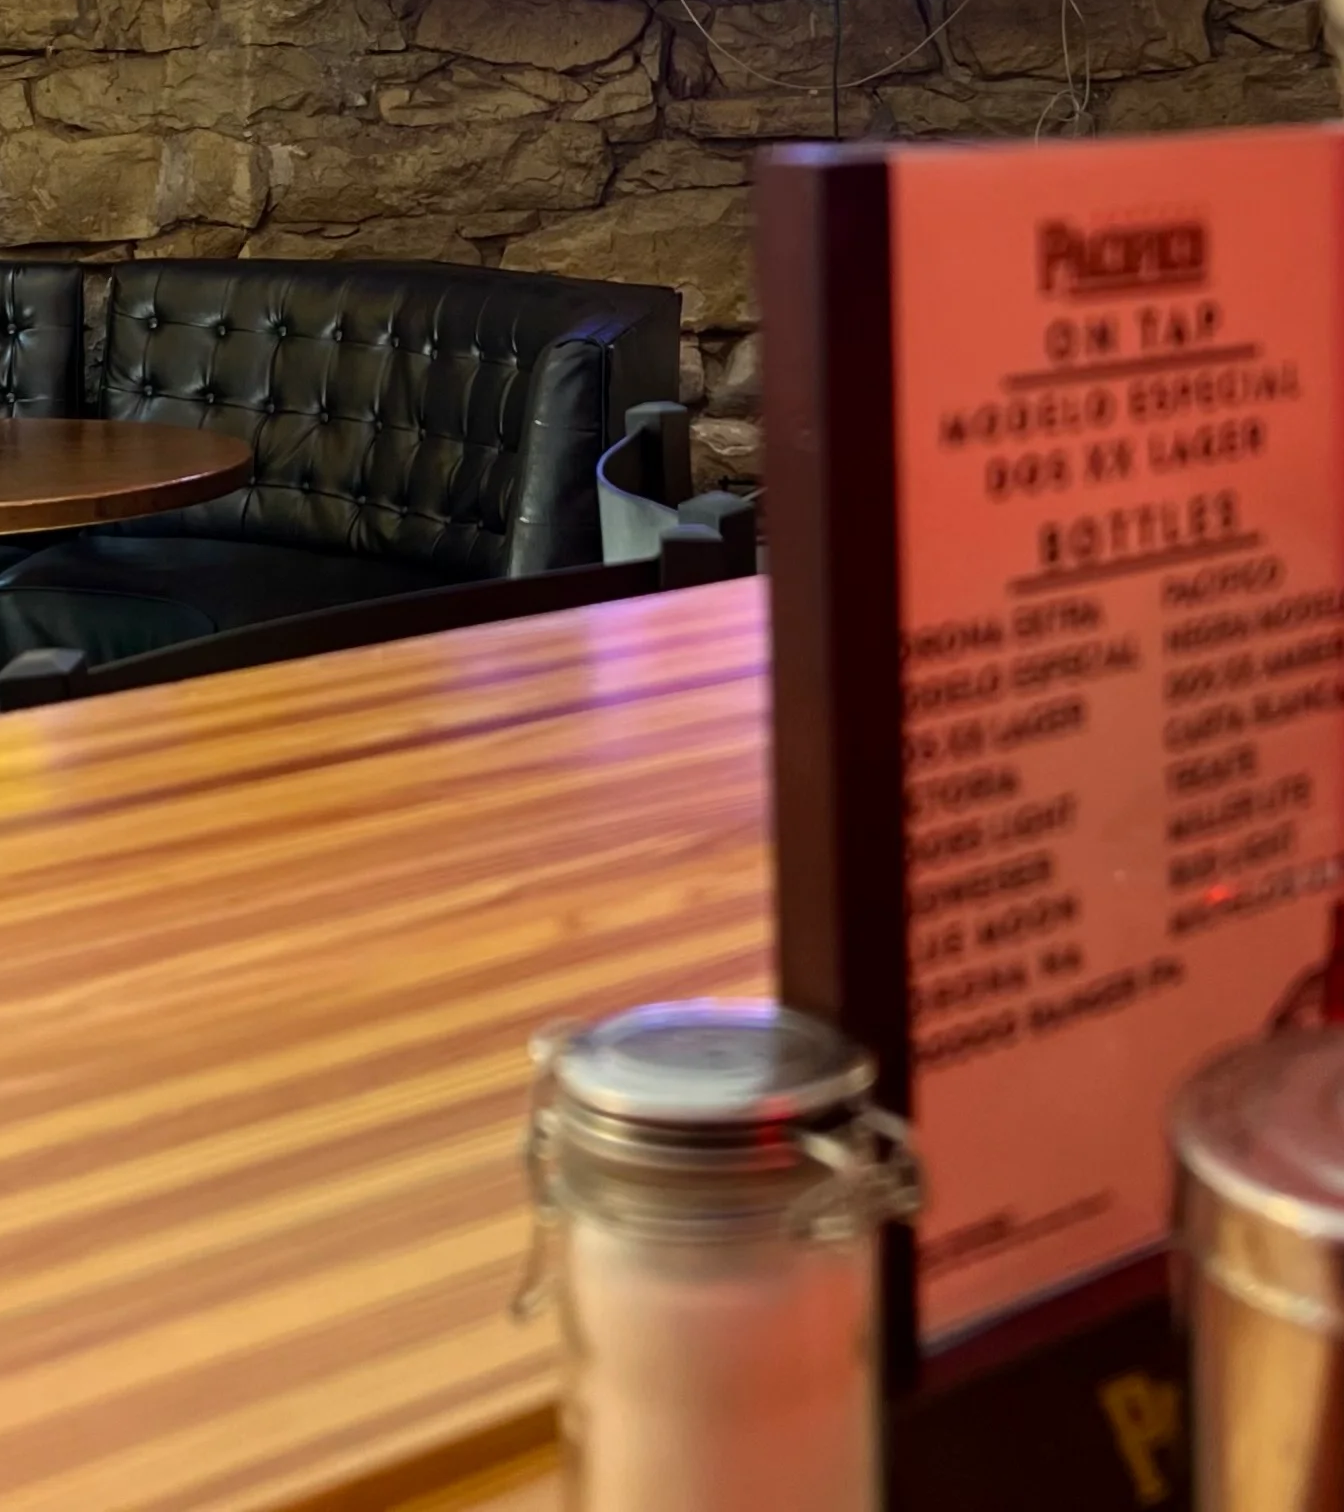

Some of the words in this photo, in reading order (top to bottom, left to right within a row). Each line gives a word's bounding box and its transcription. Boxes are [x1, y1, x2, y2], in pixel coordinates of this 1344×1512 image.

[1046, 316, 1119, 364] ON
[1136, 300, 1221, 350] TAP
[941, 390, 1116, 447] MODELO
[1128, 362, 1299, 422] ESPECIAL
[985, 452, 1067, 500] DOS
[1148, 417, 1264, 473] LAGER
[1039, 490, 1241, 566] BOTTLES
